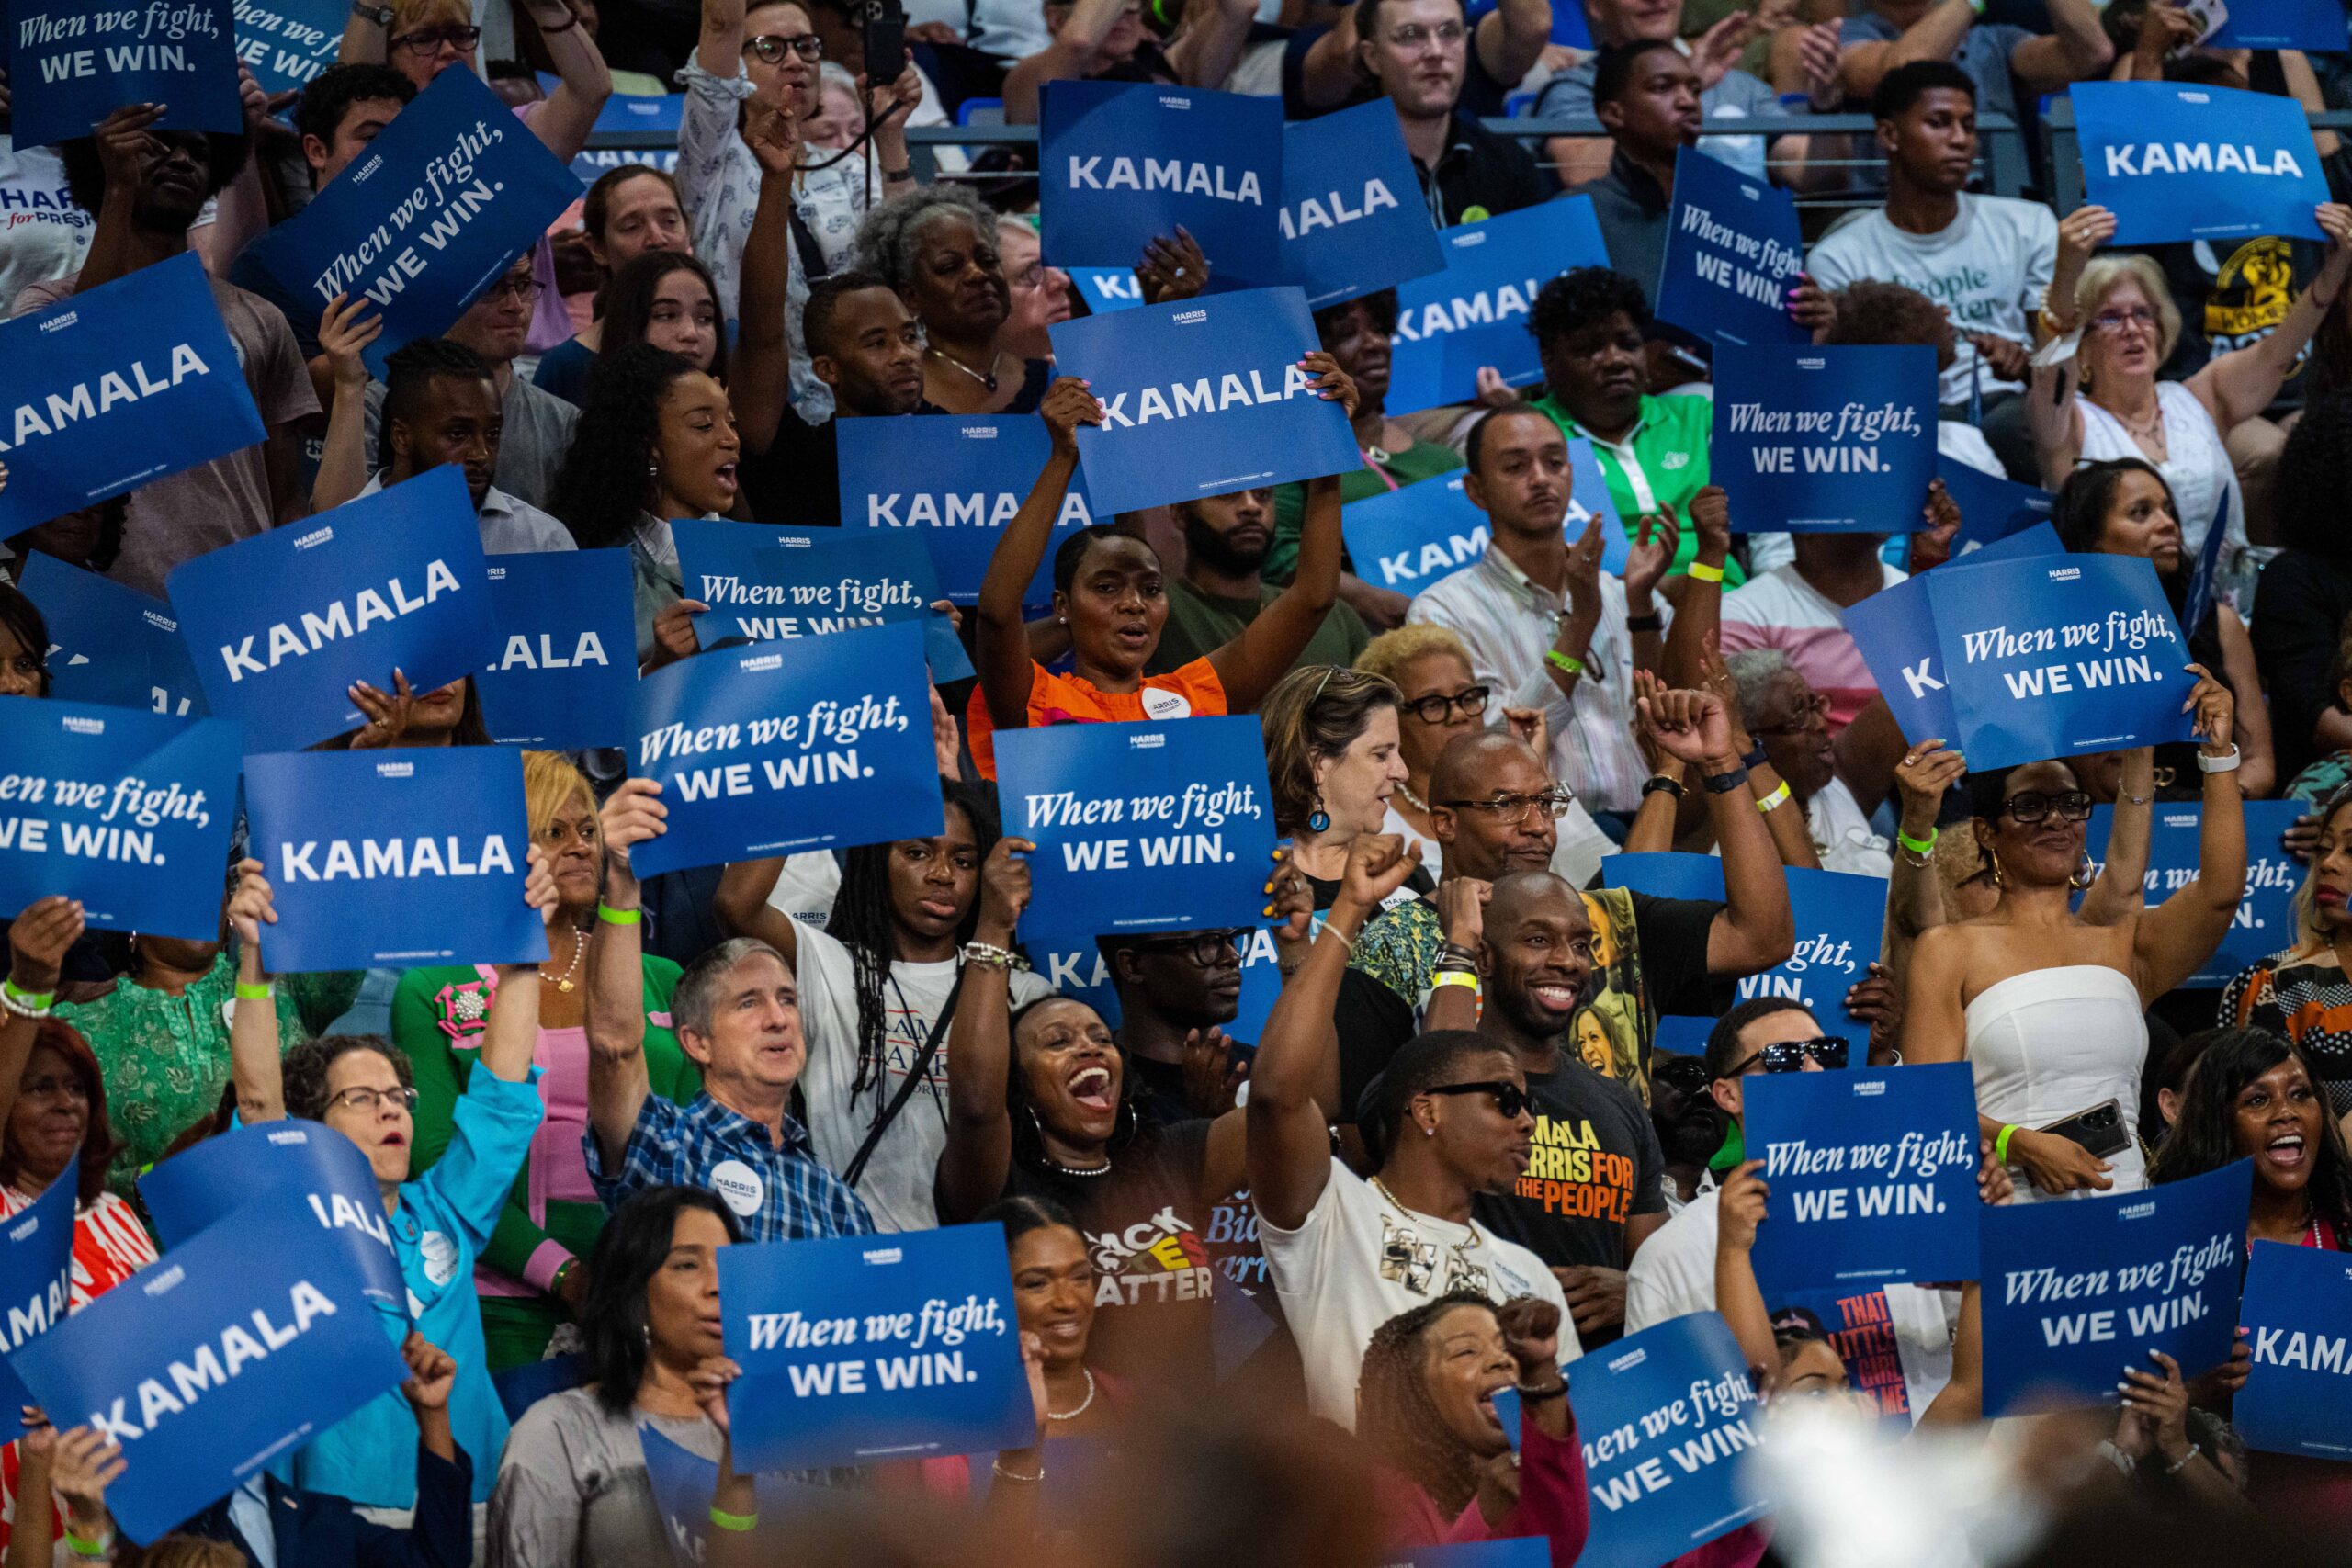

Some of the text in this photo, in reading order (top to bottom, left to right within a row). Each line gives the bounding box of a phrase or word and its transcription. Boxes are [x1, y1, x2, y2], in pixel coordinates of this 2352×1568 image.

[19, 1, 220, 49] When we fight,
[233, 0, 284, 31] hen
[281, 20, 325, 46] we
[40, 45, 196, 84] WE WIN.
[1159, 96, 1191, 106] HARRIS
[352, 154, 382, 184] HARRIS
[1069, 156, 1263, 206] KAMALA
[2104, 142, 2304, 178] KAMALA
[6, 212, 35, 230] for
[313, 225, 392, 304] When
[390, 187, 429, 231] we
[425, 120, 503, 208] fight,
[1680, 203, 1735, 250] When
[1735, 232, 1761, 260] we
[364, 246, 428, 307] WE
[419, 178, 504, 251] WIN.
[1696, 251, 1785, 311] WE WIN.
[39, 310, 78, 332] HARRIS
[1173, 310, 1207, 322] HARRIS
[0, 343, 210, 452] AMALA
[1096, 364, 1320, 432] KAMALA
[962, 426, 999, 435] HARRIS
[1729, 402, 1921, 442] When we fight,
[1752, 446, 1891, 473] WE WIN.
[868, 492, 1093, 528] KAMAA
[293, 526, 334, 549] HARRIS
[779, 536, 811, 545] HARRIS
[701, 575, 922, 613] When we fight,
[2049, 568, 2081, 579] HARRIS
[142, 610, 178, 630] HARRIS
[220, 559, 460, 682] KAMALA
[1962, 610, 2177, 663] When we fight,
[741, 654, 782, 670] HARRIS
[2004, 655, 2163, 699] WE WIN.
[640, 694, 909, 767] When we fight,
[1130, 734, 1165, 743] HARRIS
[675, 749, 875, 803] WE WIN.
[53, 780, 107, 809] we
[101, 776, 210, 829] fight,
[1025, 782, 1261, 829] When we fight,
[2164, 815, 2198, 823] HARRIS
[61, 821, 166, 866] WIN.
[281, 834, 514, 883] KAMALA
[1062, 833, 1235, 872] WE WIN.
[1785, 933, 1856, 975] ght,
[1591, 1152, 1634, 1191] FOR
[1766, 1130, 1973, 1179] When we fight,
[716, 1177, 756, 1194] HARRIS
[1544, 1180, 1633, 1224] PEOPLE
[1792, 1183, 1947, 1223] WE WIN.
[2119, 1201, 2155, 1216] HARRIS
[1094, 1267, 1213, 1308] ATTER
[2005, 1233, 2234, 1306] When we fight,
[748, 1295, 1006, 1351] When we fight,
[2041, 1291, 2210, 1348] WE WIN.
[90, 1280, 336, 1448] KAMALA
[788, 1351, 978, 1397] WE WIN.
[1639, 1403, 1689, 1439] we
[1592, 1419, 1765, 1512] WE WIN.
